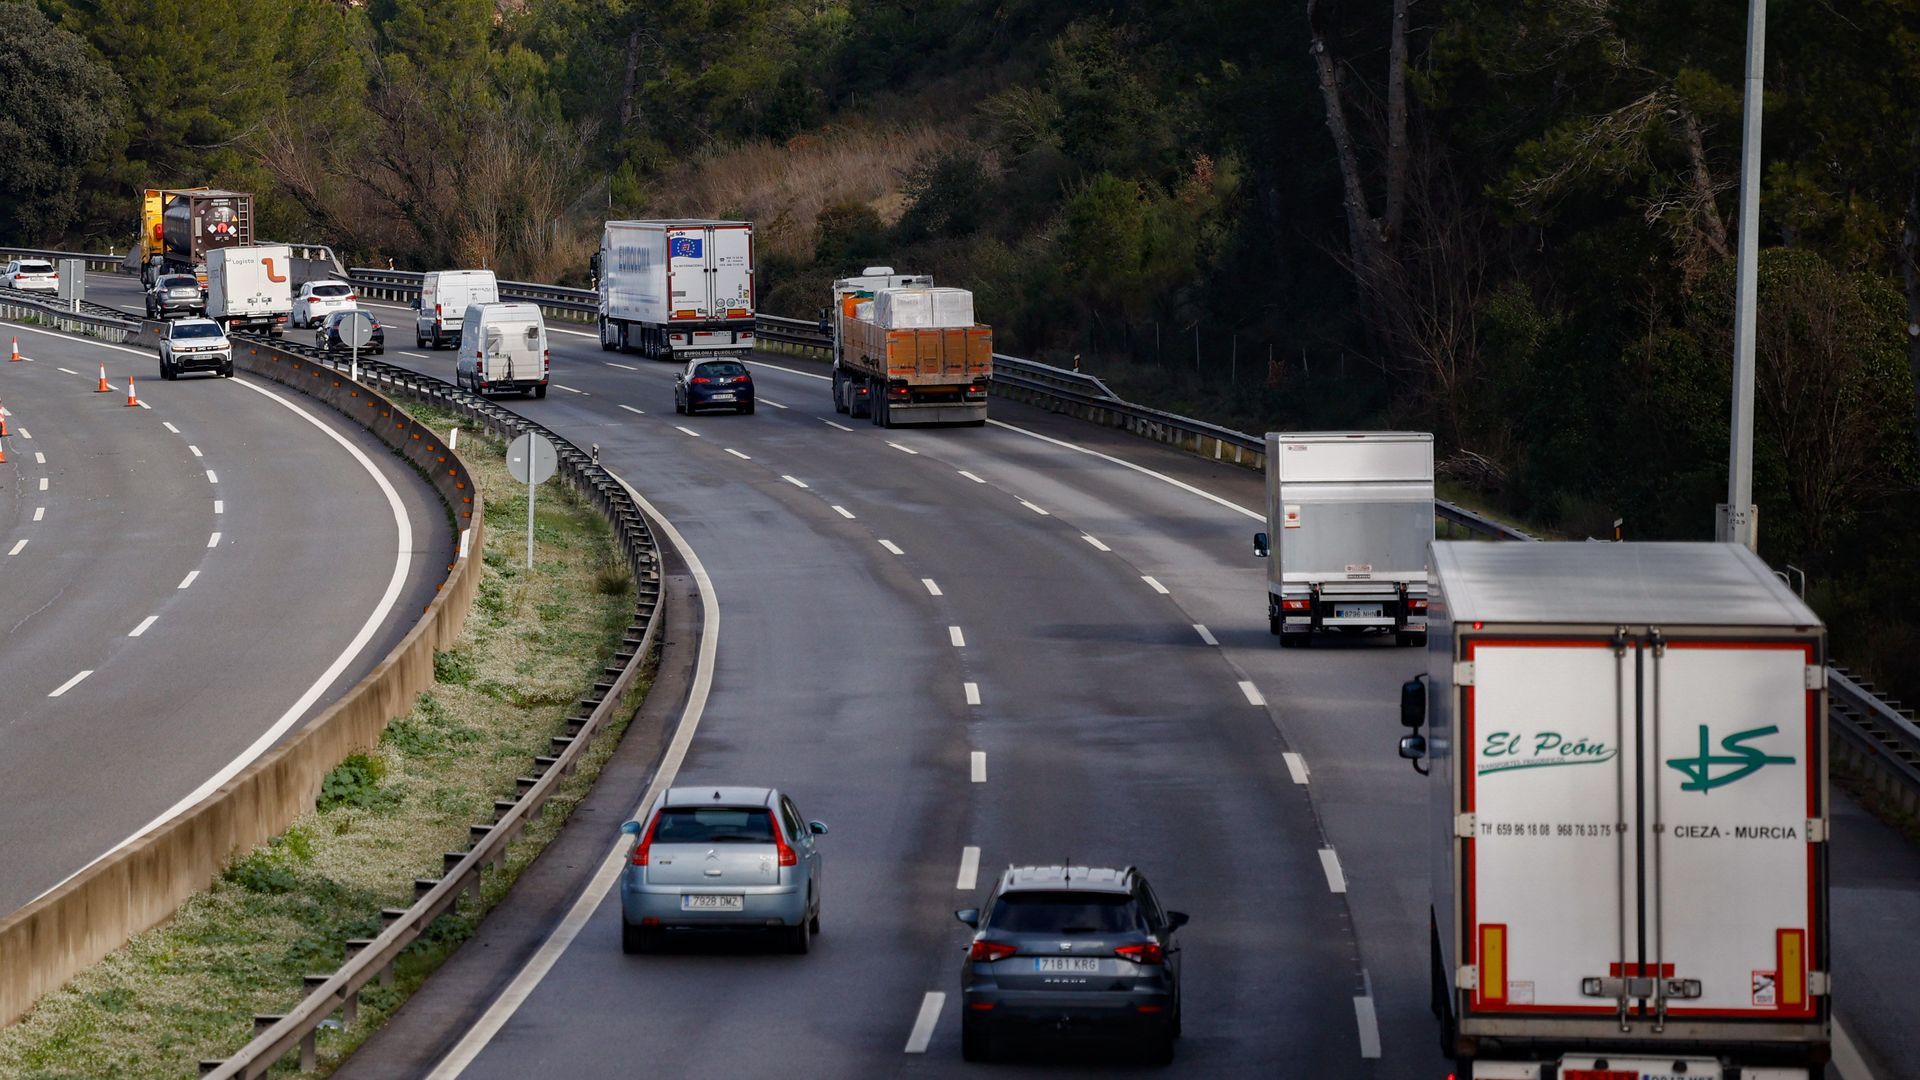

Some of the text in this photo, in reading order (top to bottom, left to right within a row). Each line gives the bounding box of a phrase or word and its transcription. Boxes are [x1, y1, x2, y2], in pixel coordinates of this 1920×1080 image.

[1483, 731, 1608, 757] El Peón
[1497, 824, 1512, 836] 659
[1514, 824, 1524, 836] 96
[1528, 824, 1537, 836] 18
[1540, 824, 1550, 836] 08
[1557, 824, 1572, 836] 968
[1575, 824, 1585, 836] 76
[1588, 824, 1598, 837] 33
[1601, 824, 1611, 837] 75
[1674, 825, 1720, 838] CIEZA
[1735, 826, 1797, 839] MURCIA
[694, 896, 737, 906] 7928 DMZ
[1042, 959, 1096, 970] 7181 KRG
